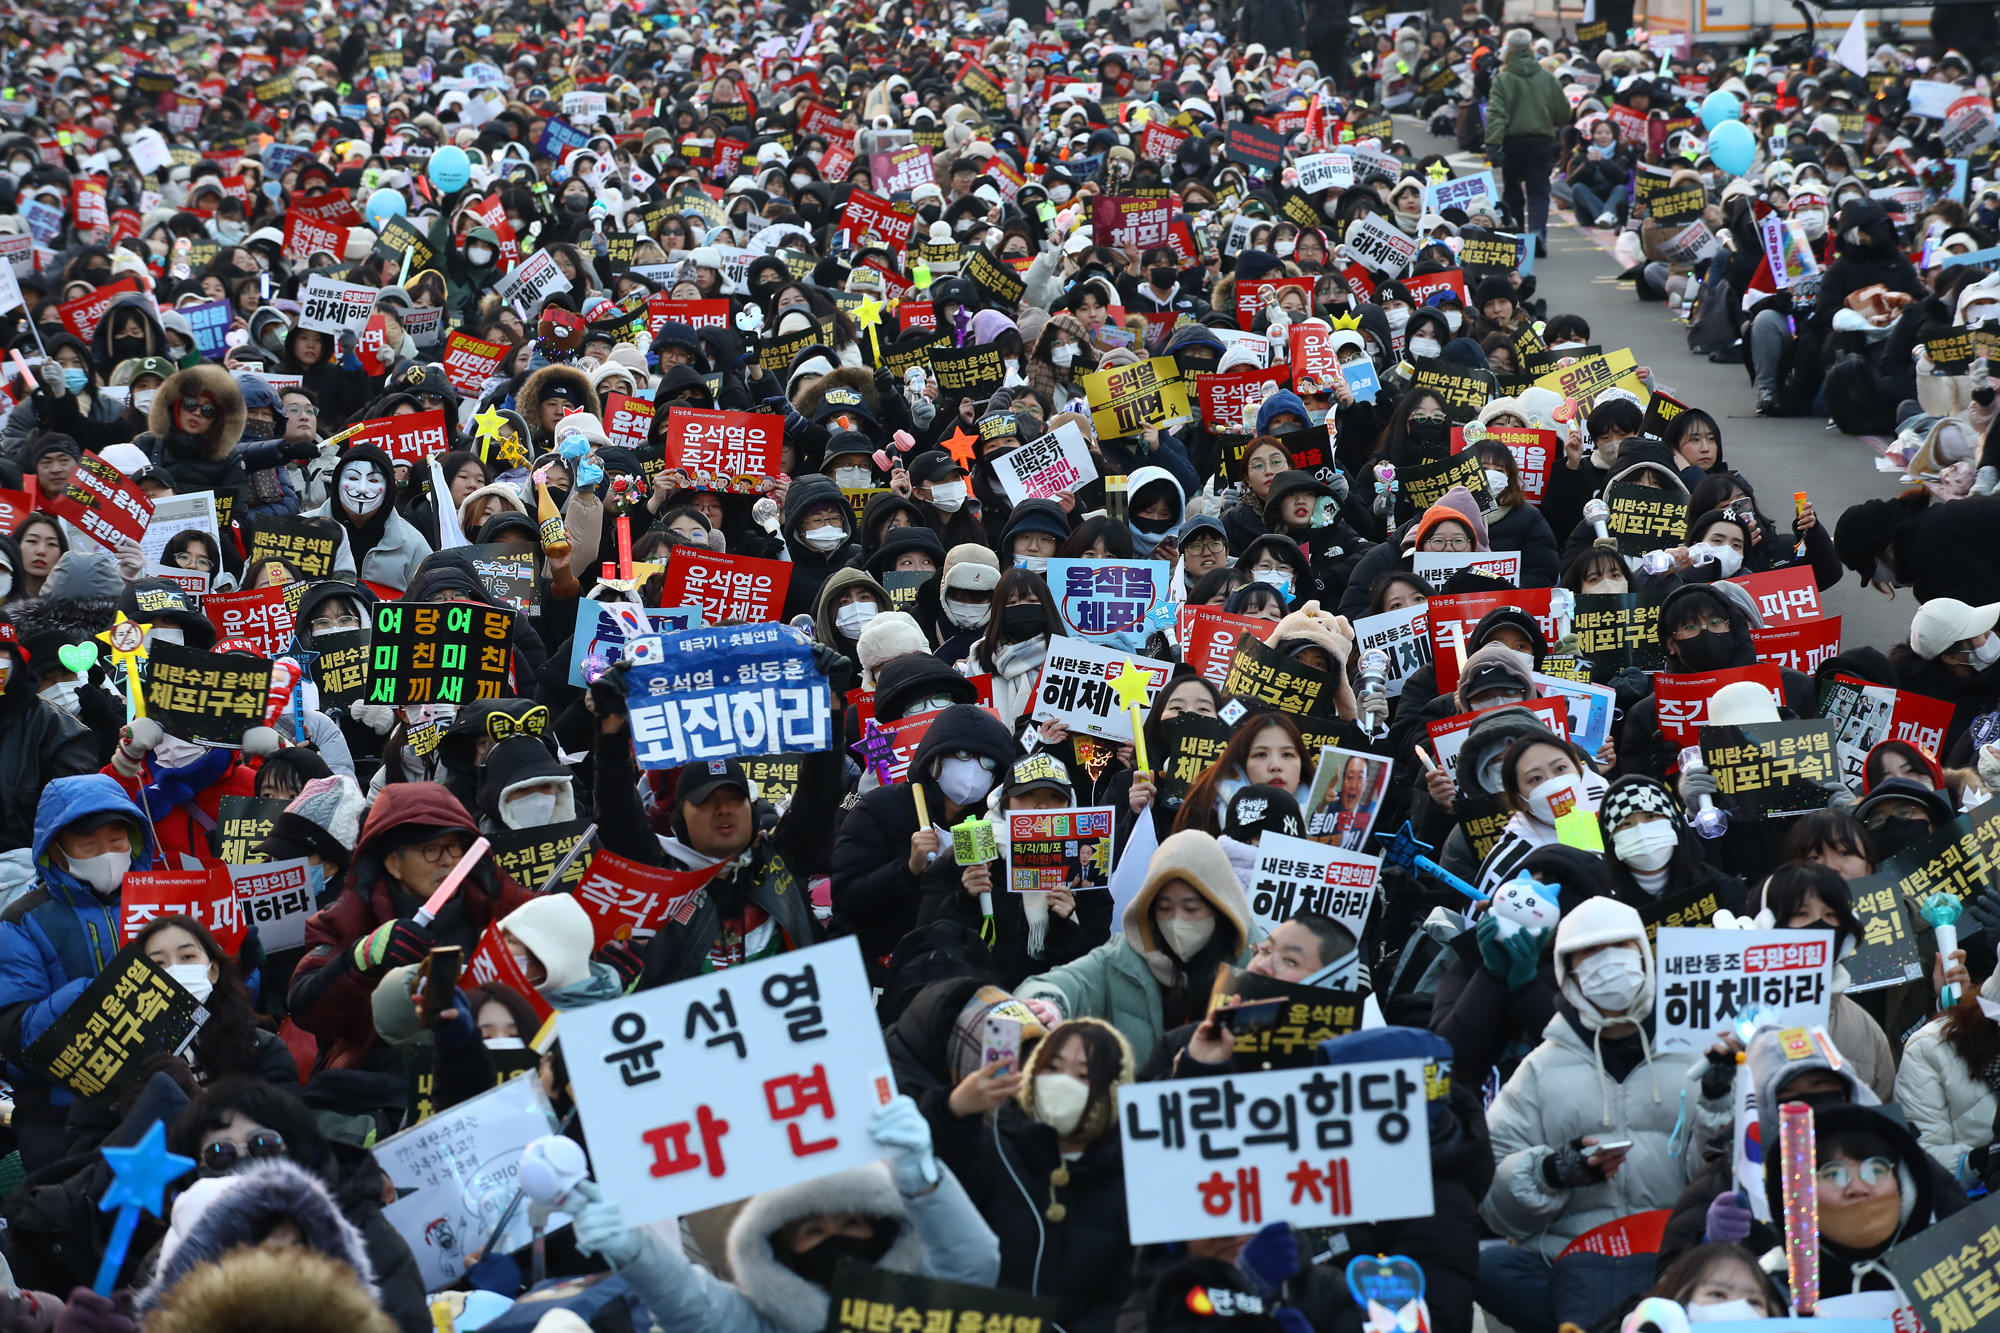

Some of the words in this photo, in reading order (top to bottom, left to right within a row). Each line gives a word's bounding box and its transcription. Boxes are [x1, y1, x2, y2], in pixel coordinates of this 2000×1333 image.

[898, 153, 929, 172] 윤석열
[888, 164, 933, 195] 체포!
[1301, 165, 1351, 186] 해체하라
[1436, 179, 1485, 201] 윤석열
[321, 198, 353, 218] 파면
[1121, 201, 1157, 212] 반란수괴
[1126, 209, 1168, 226] 윤석열
[1652, 200, 1704, 217] 체포!구속!
[846, 202, 880, 231] 즉각
[881, 215, 911, 240] 파면
[1363, 223, 1390, 241] 내란동조
[294, 220, 338, 249] 윤석열은
[1111, 222, 1168, 248] 체포!
[1495, 241, 1518, 253] 윤석열
[1352, 233, 1408, 268] 해체하라
[1460, 249, 1516, 266] 체포!구속!
[503, 278, 525, 300] 내란동조
[521, 254, 548, 281] 국민의힘
[309, 288, 342, 299] 내란동조
[344, 291, 376, 303] 국민의힘
[305, 299, 371, 324] 해체하라
[450, 336, 501, 357] 윤석열을
[793, 333, 817, 350] 윤석열
[1928, 334, 1967, 349] 내란수괴
[968, 351, 1000, 368] 윤석열
[937, 363, 1003, 390] 체포!구속!
[1108, 361, 1157, 399] 윤석열
[1418, 371, 1460, 389] 내란수괴
[1461, 374, 1488, 391] 윤석열
[1560, 357, 1613, 398] 윤석열
[1210, 381, 1261, 404] 윤석열
[673, 409, 692, 417] 나눔문화
[1114, 390, 1166, 434] 파면
[399, 426, 447, 455] 파면
[682, 422, 767, 446] 윤석열은
[1500, 433, 1539, 446] 신속하게
[681, 449, 723, 473] 즉각
[725, 450, 766, 476] 체포
[1009, 433, 1059, 469] 내란공범
[1016, 445, 1064, 482] 한덕수가
[1021, 457, 1070, 493] 거부권이
[1404, 476, 1449, 495] 내란수괴
[1449, 456, 1479, 478] 윤석열
[113, 489, 150, 529] 윤석열
[1611, 498, 1660, 517] 내란수괴
[1661, 502, 1688, 518] 윤석
[1608, 512, 1688, 540] 체포!구속
[254, 531, 291, 547] 내란수괴
[292, 535, 333, 554] 윤석열
[675, 548, 697, 558] 나눔문화
[698, 554, 735, 564] www.nanum.com
[684, 565, 772, 601] 윤석열은
[1065, 566, 1152, 599] 윤석열
[226, 593, 264, 603] www.nanum.com
[680, 592, 727, 622] 즉각
[727, 600, 769, 623] 체포
[1432, 598, 1455, 607] 나눔문화
[1455, 597, 1497, 605] www.nanum.com
[1759, 585, 1819, 618] 파면
[1077, 601, 1145, 633] 체포!
[1200, 612, 1222, 622] 나눔문화
[1222, 619, 1263, 630] www.nanum.com
[1575, 605, 1632, 628] 내란수괴
[234, 640, 253, 651] 탄핵
[679, 636, 718, 653] 태극기
[729, 631, 778, 648] 촛불연합
[1363, 625, 1412, 649] 내란동조
[1761, 630, 1800, 640] www.nanum.com
[153, 663, 220, 688] 내란수괴
[222, 671, 267, 690] 윤석열
[648, 669, 715, 697] 윤석열
[737, 659, 805, 684] 한동훈
[1050, 656, 1105, 676] 내란동조
[1234, 651, 1276, 684] 내란수괴
[1275, 671, 1323, 698] 윤석열
[1541, 658, 1576, 673] 국지전
[1656, 677, 1674, 686] 나눔문화
[1675, 677, 1717, 686] www.nanum.com
[149, 682, 264, 719] 체포!구속!
[492, 715, 546, 739] 탄핵
[631, 686, 831, 763] 퇴진하라
[1708, 740, 1777, 767] 내란수괴
[1779, 731, 1830, 752] 윤석열
[754, 763, 799, 781] 윤석열
[1711, 752, 1833, 795] 체포!구속!
[1013, 816, 1070, 838] 윤석열
[1076, 813, 1108, 835] 탄핵
[1309, 812, 1337, 834] 좋아
[980, 847, 996, 860] OUT
[1013, 843, 1062, 854] 즉/각/체/포
[127, 877, 154, 885] 나눔문화
[155, 877, 207, 885] www.nanum.com
[237, 869, 302, 895] 국민의힘
[1261, 857, 1324, 881] 내란동조
[1328, 863, 1374, 886] 국민의힘
[581, 873, 659, 930] 즉각
[1665, 955, 1741, 975] 내란동조
[1744, 942, 1826, 972] 국민의힘
[1664, 972, 1825, 1030] 해체하라
[48, 1010, 113, 1080] 내란수괴
[101, 958, 152, 1015] 윤석열
[603, 963, 828, 1089] 윤석열
[1288, 1003, 1356, 1027] 윤석열
[68, 972, 177, 1098] 체포!구속!
[641, 1063, 840, 1179] 파면
[1126, 1068, 1417, 1161] 내란의힘당
[1197, 1157, 1352, 1224] 해체
[1913, 1225, 2000, 1300] 내란수괴
[840, 1298, 953, 1333] 내란수괴
